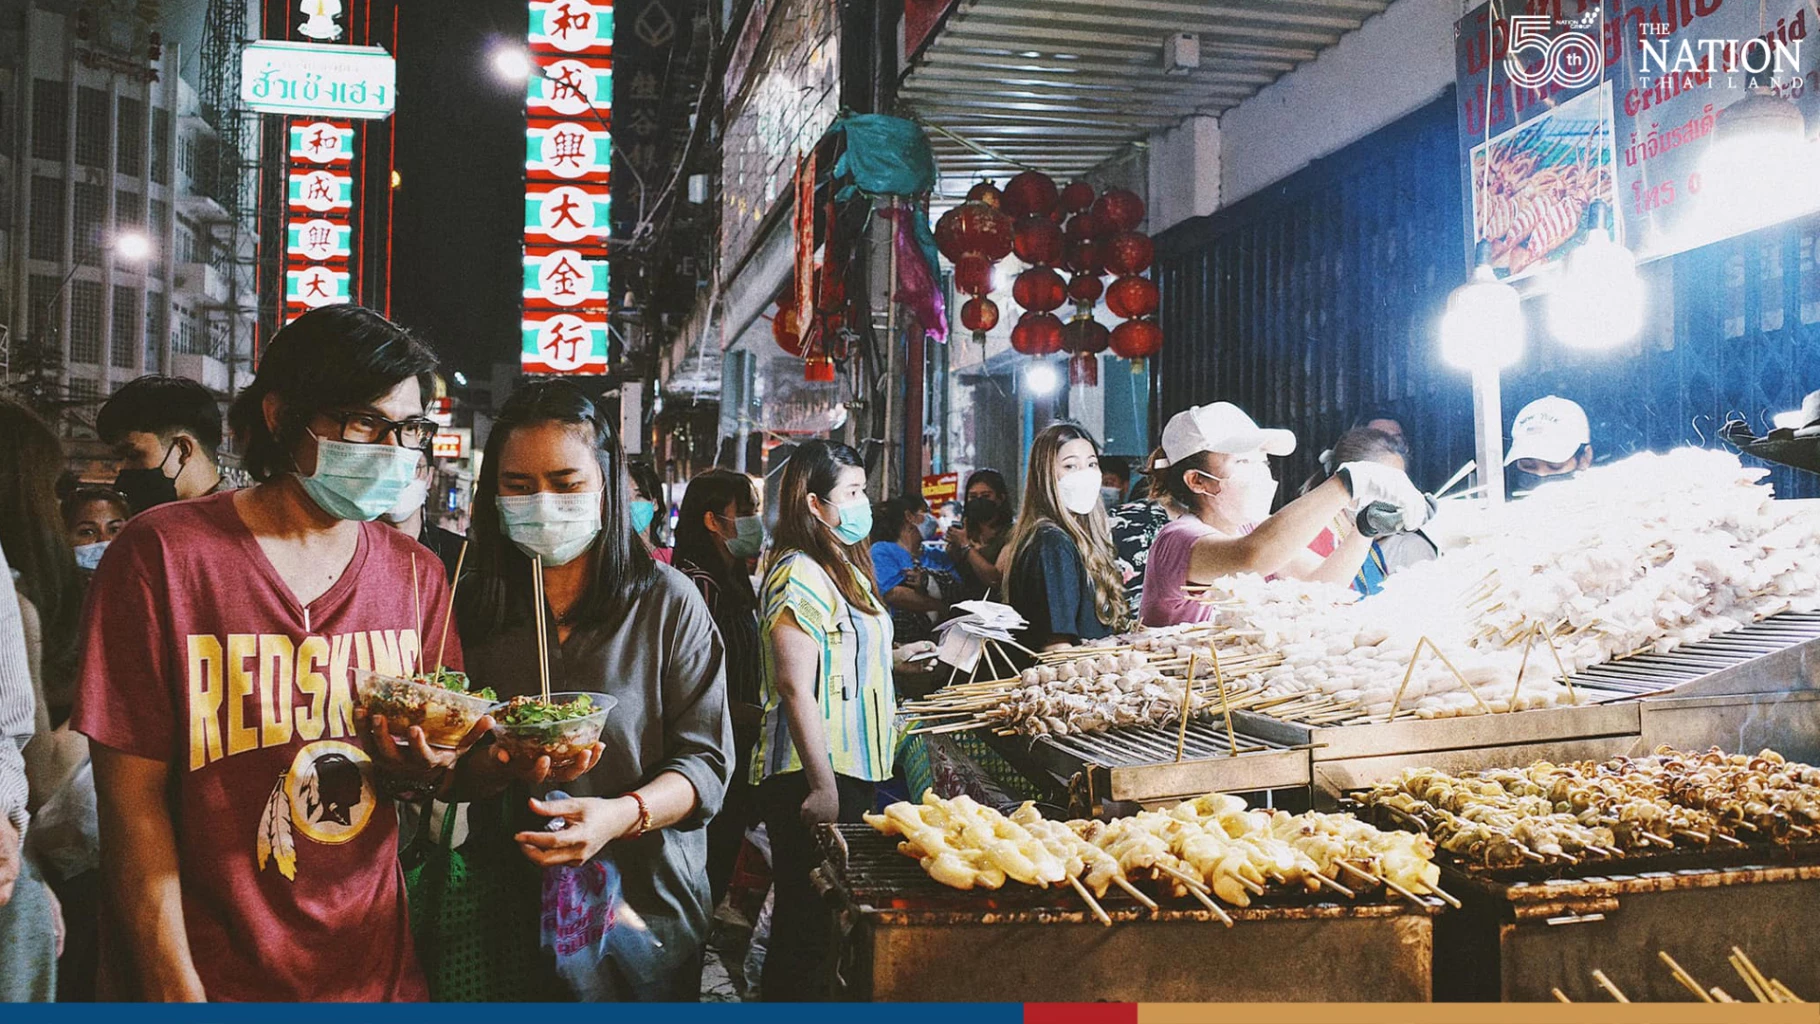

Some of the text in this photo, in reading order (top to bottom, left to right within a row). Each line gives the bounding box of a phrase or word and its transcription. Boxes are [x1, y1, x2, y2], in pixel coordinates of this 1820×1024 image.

[1721, 9, 1807, 76] Suid
[542, 2, 591, 363] 和成興大金行
[186, 629, 421, 773] REDSK
